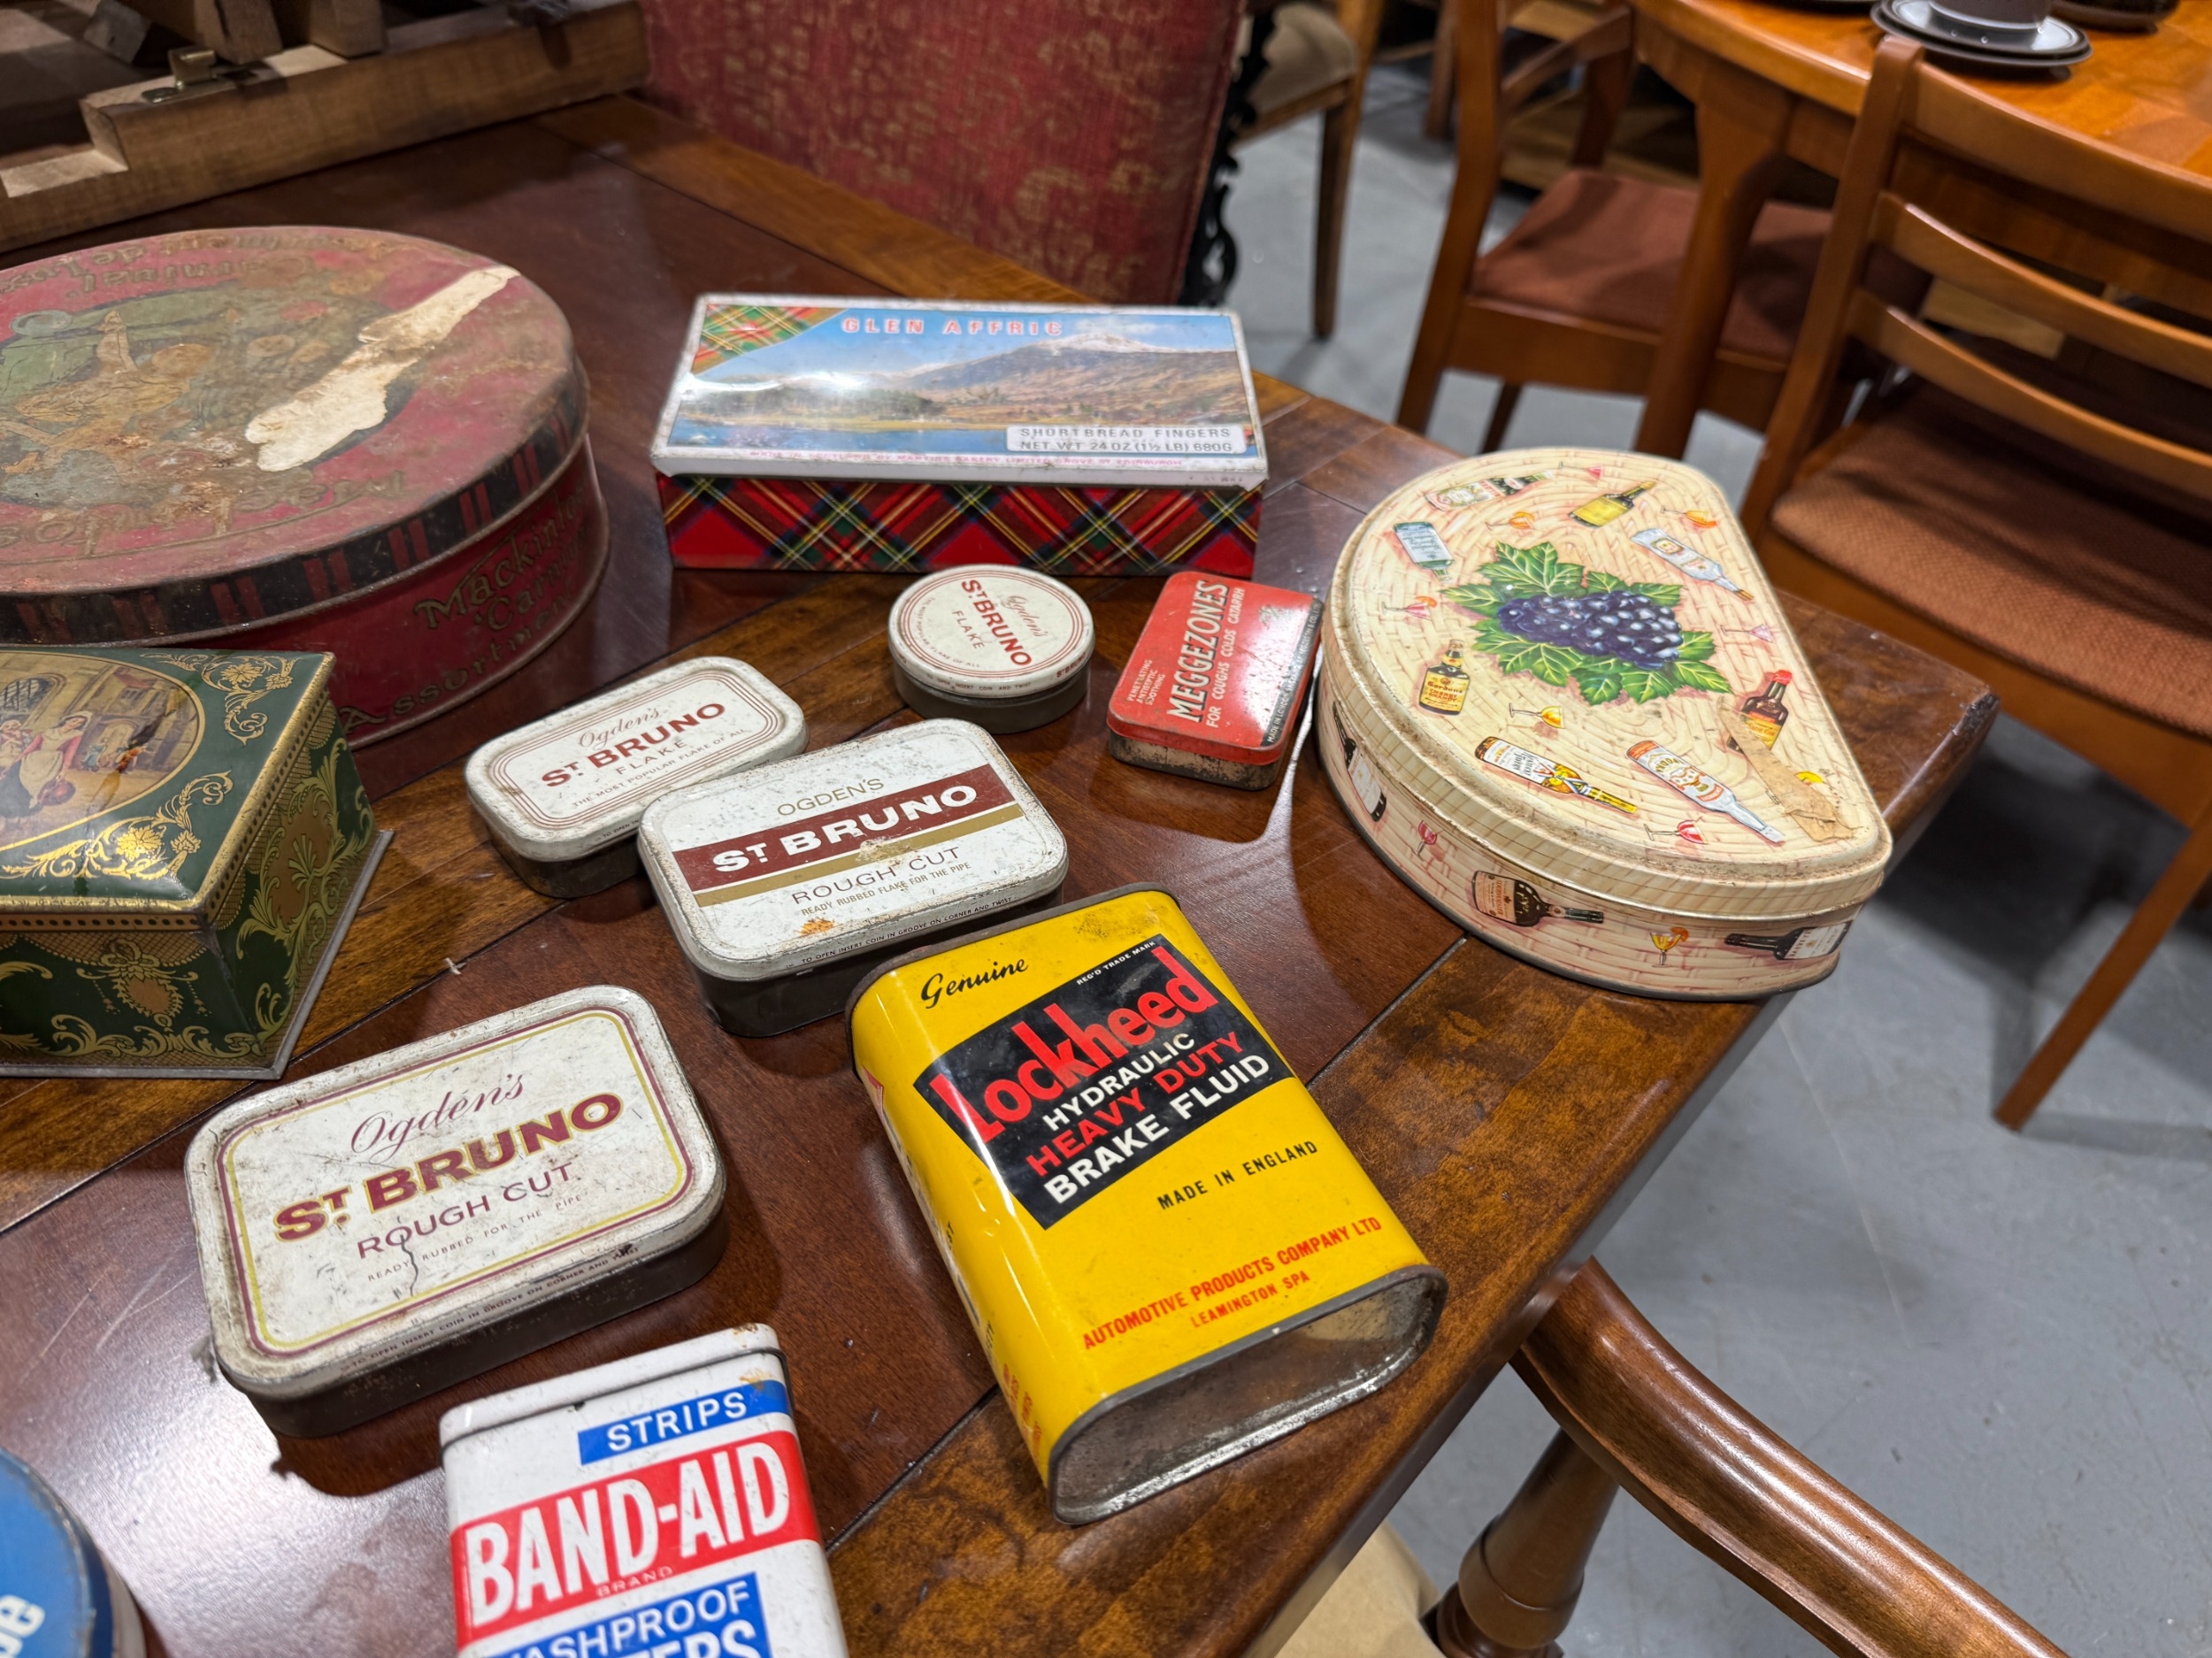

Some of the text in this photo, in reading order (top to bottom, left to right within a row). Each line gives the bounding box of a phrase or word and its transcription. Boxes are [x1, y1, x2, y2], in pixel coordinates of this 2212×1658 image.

[843, 318, 1063, 335] GLEN AFFRIC
[1020, 428, 1231, 439] SHORTBREAD FINGERS
[1020, 441, 1048, 450] NET
[1057, 442, 1081, 451] WT
[1090, 442, 1105, 451] 24
[1111, 442, 1131, 451] OZ
[1194, 443, 1232, 453] 680G
[951, 610, 986, 649] FLAKE
[973, 599, 1033, 666] BRUNO
[1001, 595, 1049, 637] Ogden's
[1126, 659, 1153, 702] PENETRATING
[1166, 580, 1230, 724] MEGGEZONES
[1206, 587, 1246, 728] FOR COUGHS COLDS CATARRH
[1136, 669, 1158, 704] ANTISEPTIC
[1145, 673, 1166, 706] SOOTHING
[579, 708, 660, 750] Ogden's
[588, 703, 726, 769] BRUNO
[1266, 724, 1279, 742] MADE
[1272, 716, 1281, 725] IN
[572, 796, 593, 807] THE
[595, 782, 626, 797] MOST
[627, 759, 676, 782] POPULAR
[679, 745, 709, 761] FLAKE
[729, 728, 747, 737] ALL
[615, 741, 687, 775] FLAKE
[777, 778, 884, 816] OGDEN'S
[780, 785, 978, 856] BRUNO
[613, 823, 631, 835] OPEN
[792, 847, 960, 904] ROUGH CUT
[801, 862, 972, 916] READY RUBBED FLAKE FOR THE PIPE
[815, 949, 836, 961] OPEN
[839, 941, 863, 954] INSERT
[866, 934, 886, 945] COIN
[898, 923, 928, 935] GROOVE
[944, 910, 972, 922] CORNER
[992, 897, 1011, 907] TWIST
[920, 958, 1029, 1009] Genuine
[1076, 940, 1156, 986] REG'D TRADE MARK
[929, 946, 1219, 1145] Lockheed
[1025, 1031, 1245, 1178] HEAVY DUTY
[1042, 1032, 1195, 1132] HYDRAULIC
[350, 1072, 524, 1164] Ogden's
[1043, 1054, 1270, 1204] BRAKE FLUID
[363, 1092, 625, 1214] BRUNO
[1156, 1140, 1318, 1209] MADE IN ENGLAND
[357, 1162, 573, 1260] ROUGH CUT
[367, 1194, 583, 1282] READY RUBBED FOR THE PIPE
[370, 1346, 398, 1362] OPEN
[401, 1330, 436, 1347] INSERT
[468, 1311, 480, 1321] IN
[526, 1285, 543, 1296] ON
[546, 1270, 586, 1286] CORNER
[588, 1259, 609, 1271] AND
[1082, 1217, 1382, 1350] AUTOMOTIVE PRODUCTS COMPANY LTD
[1190, 1270, 1310, 1328] LEAMINGTON SPA
[607, 1391, 748, 1453] STRIPS
[465, 1441, 789, 1628] BAND-AID
[596, 1566, 673, 1598] BRAND
[508, 1580, 750, 1658] ASHPROOF
